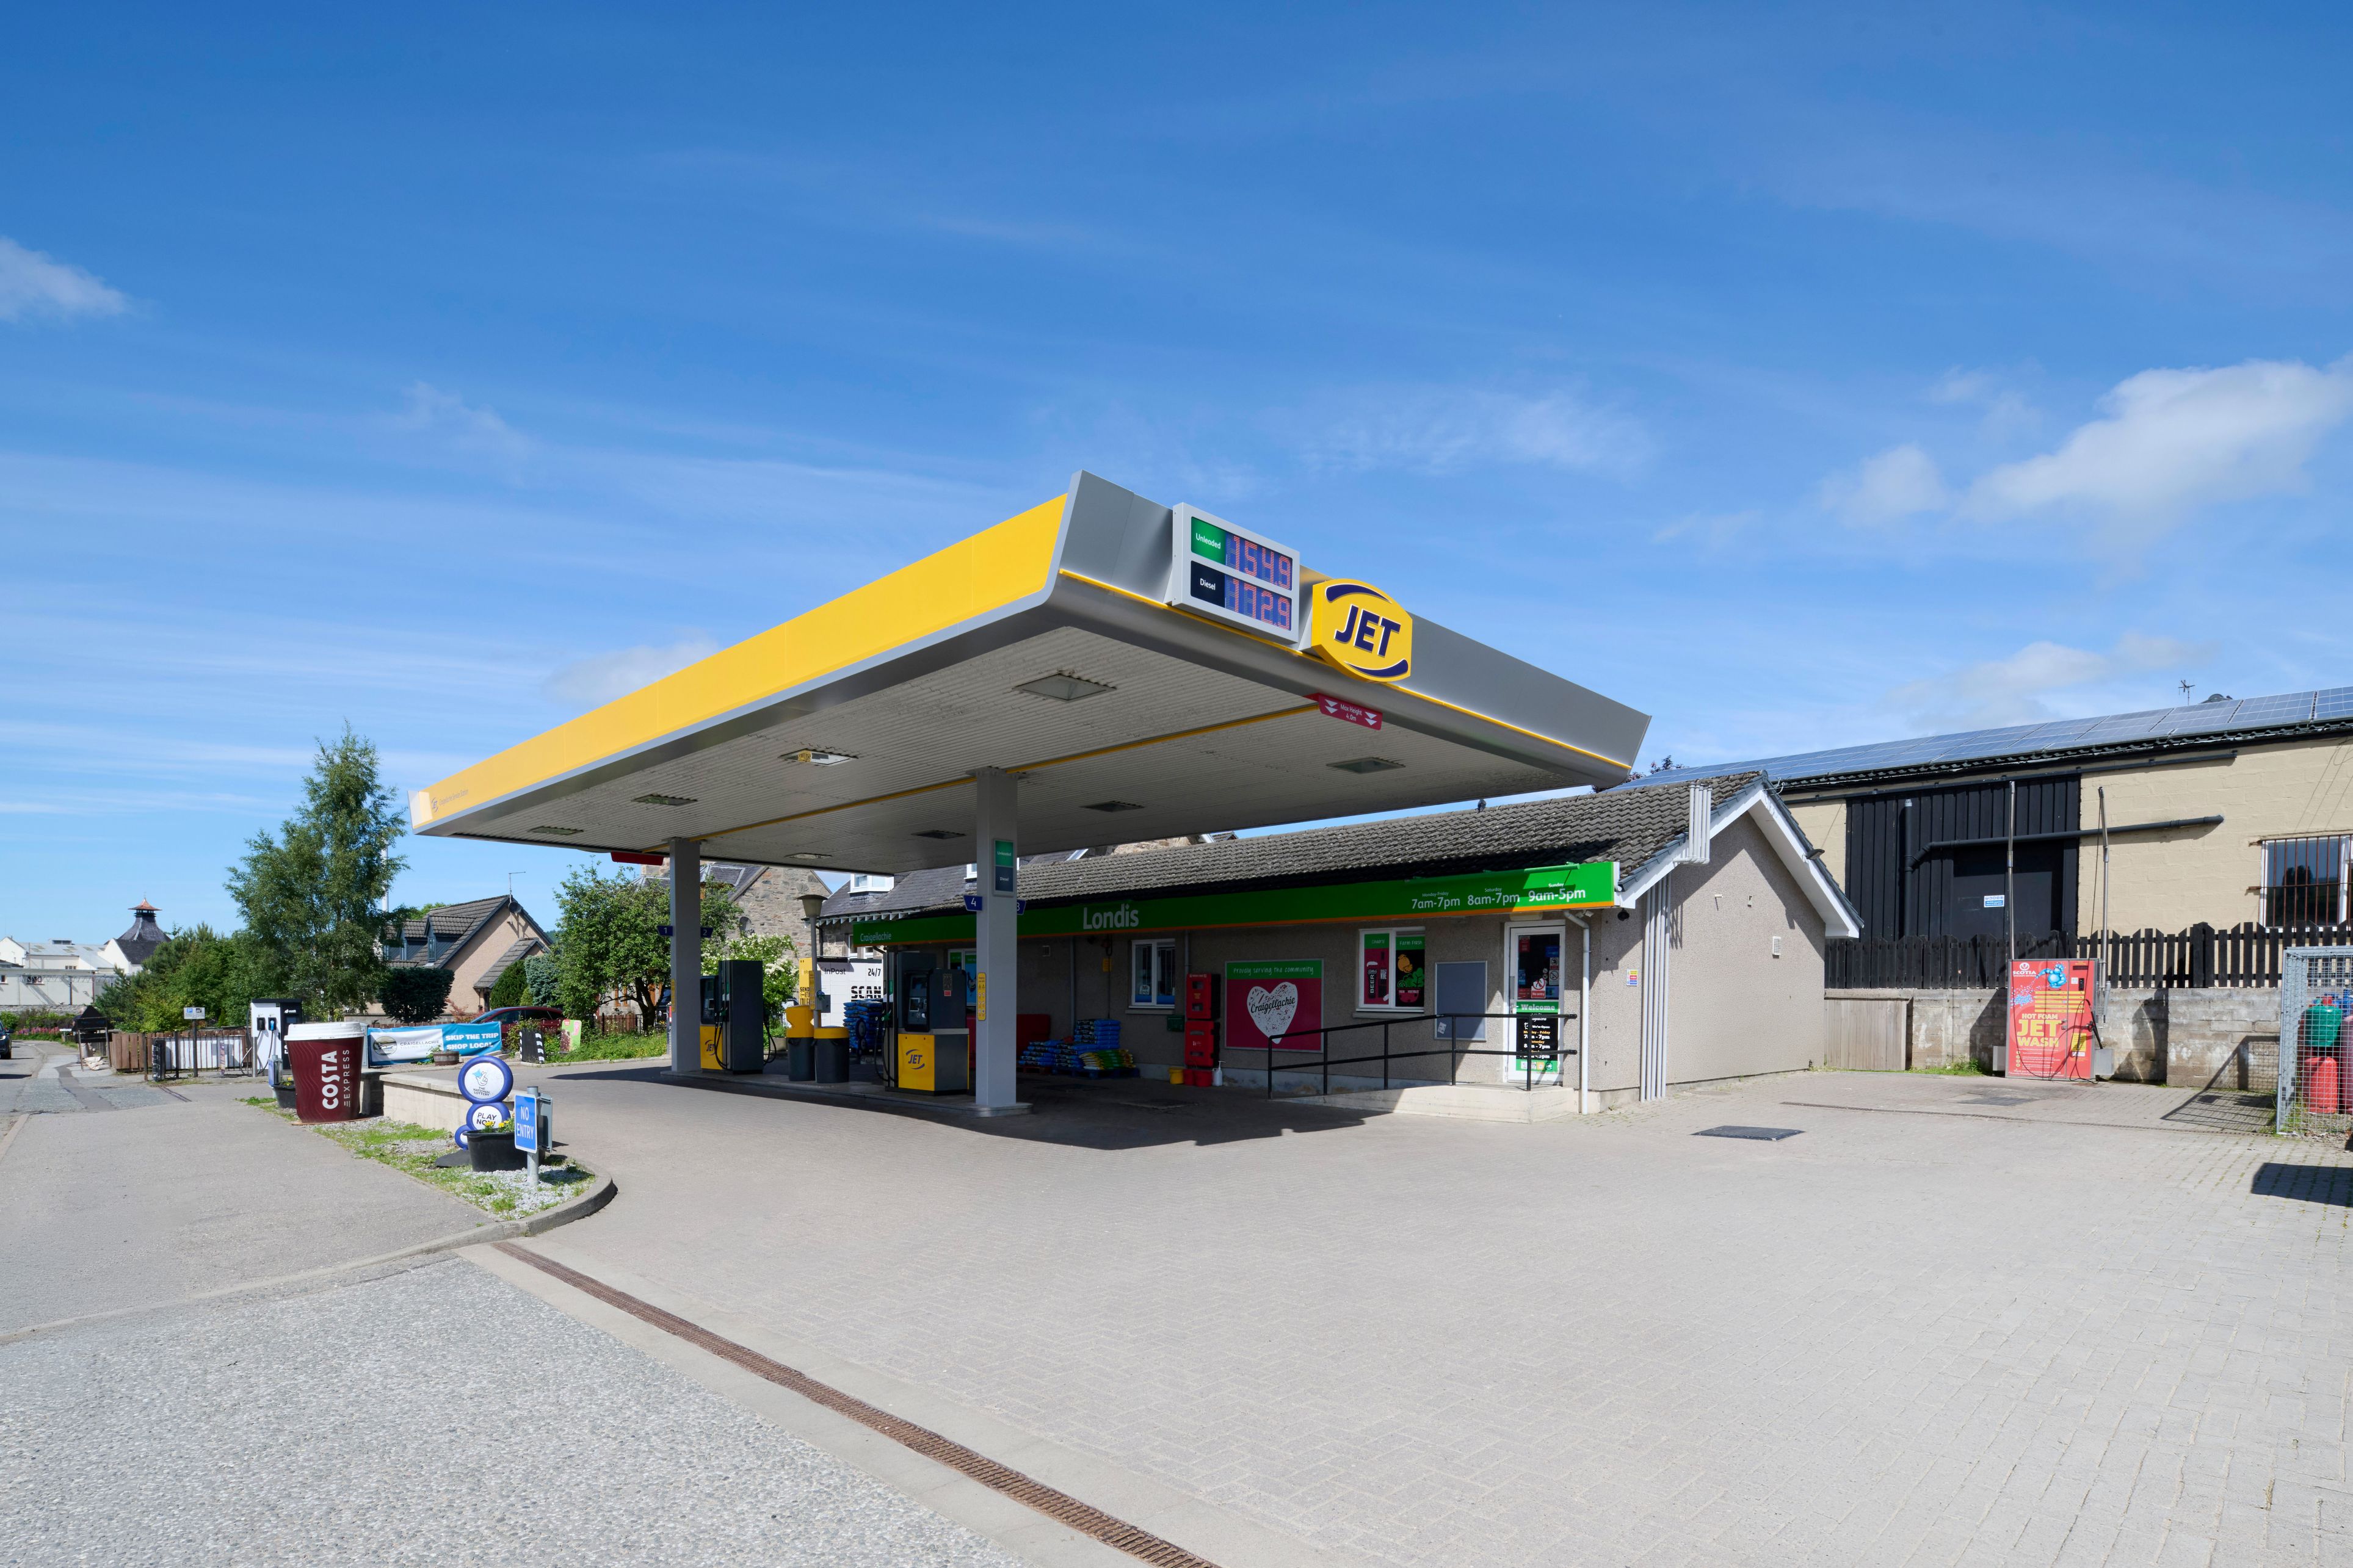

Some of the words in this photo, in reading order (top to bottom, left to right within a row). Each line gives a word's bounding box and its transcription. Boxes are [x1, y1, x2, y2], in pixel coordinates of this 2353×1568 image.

[1195, 532, 1221, 549] Unleaded
[1233, 535, 1291, 590] 154.9
[1200, 578, 1216, 590] Diesel
[1233, 578, 1290, 630] 172.9
[1333, 604, 1401, 658] JET
[1340, 703, 1349, 712] Max
[1349, 706, 1362, 716] Height
[971, 897, 976, 907] 4
[1467, 893, 1520, 906] 8am-7pm
[1528, 889, 1586, 903] 9am-5pm
[1412, 897, 1460, 909] 7am-7pm
[1083, 903, 1139, 930] Londis
[860, 931, 891, 943] Craigellachie
[868, 968, 881, 977] 24/7
[1253, 967, 1272, 975] serving
[1285, 966, 1313, 975] community
[851, 986, 882, 999] SCAN
[1250, 996, 1295, 1014] Craigellachie
[2017, 1019, 2062, 1037] JET
[2017, 1036, 2059, 1047] WASH
[908, 1054, 923, 1064] JET
[321, 1050, 340, 1109] COSTA
[521, 1106, 529, 1121] NO
[517, 1122, 534, 1140] ENTRY
